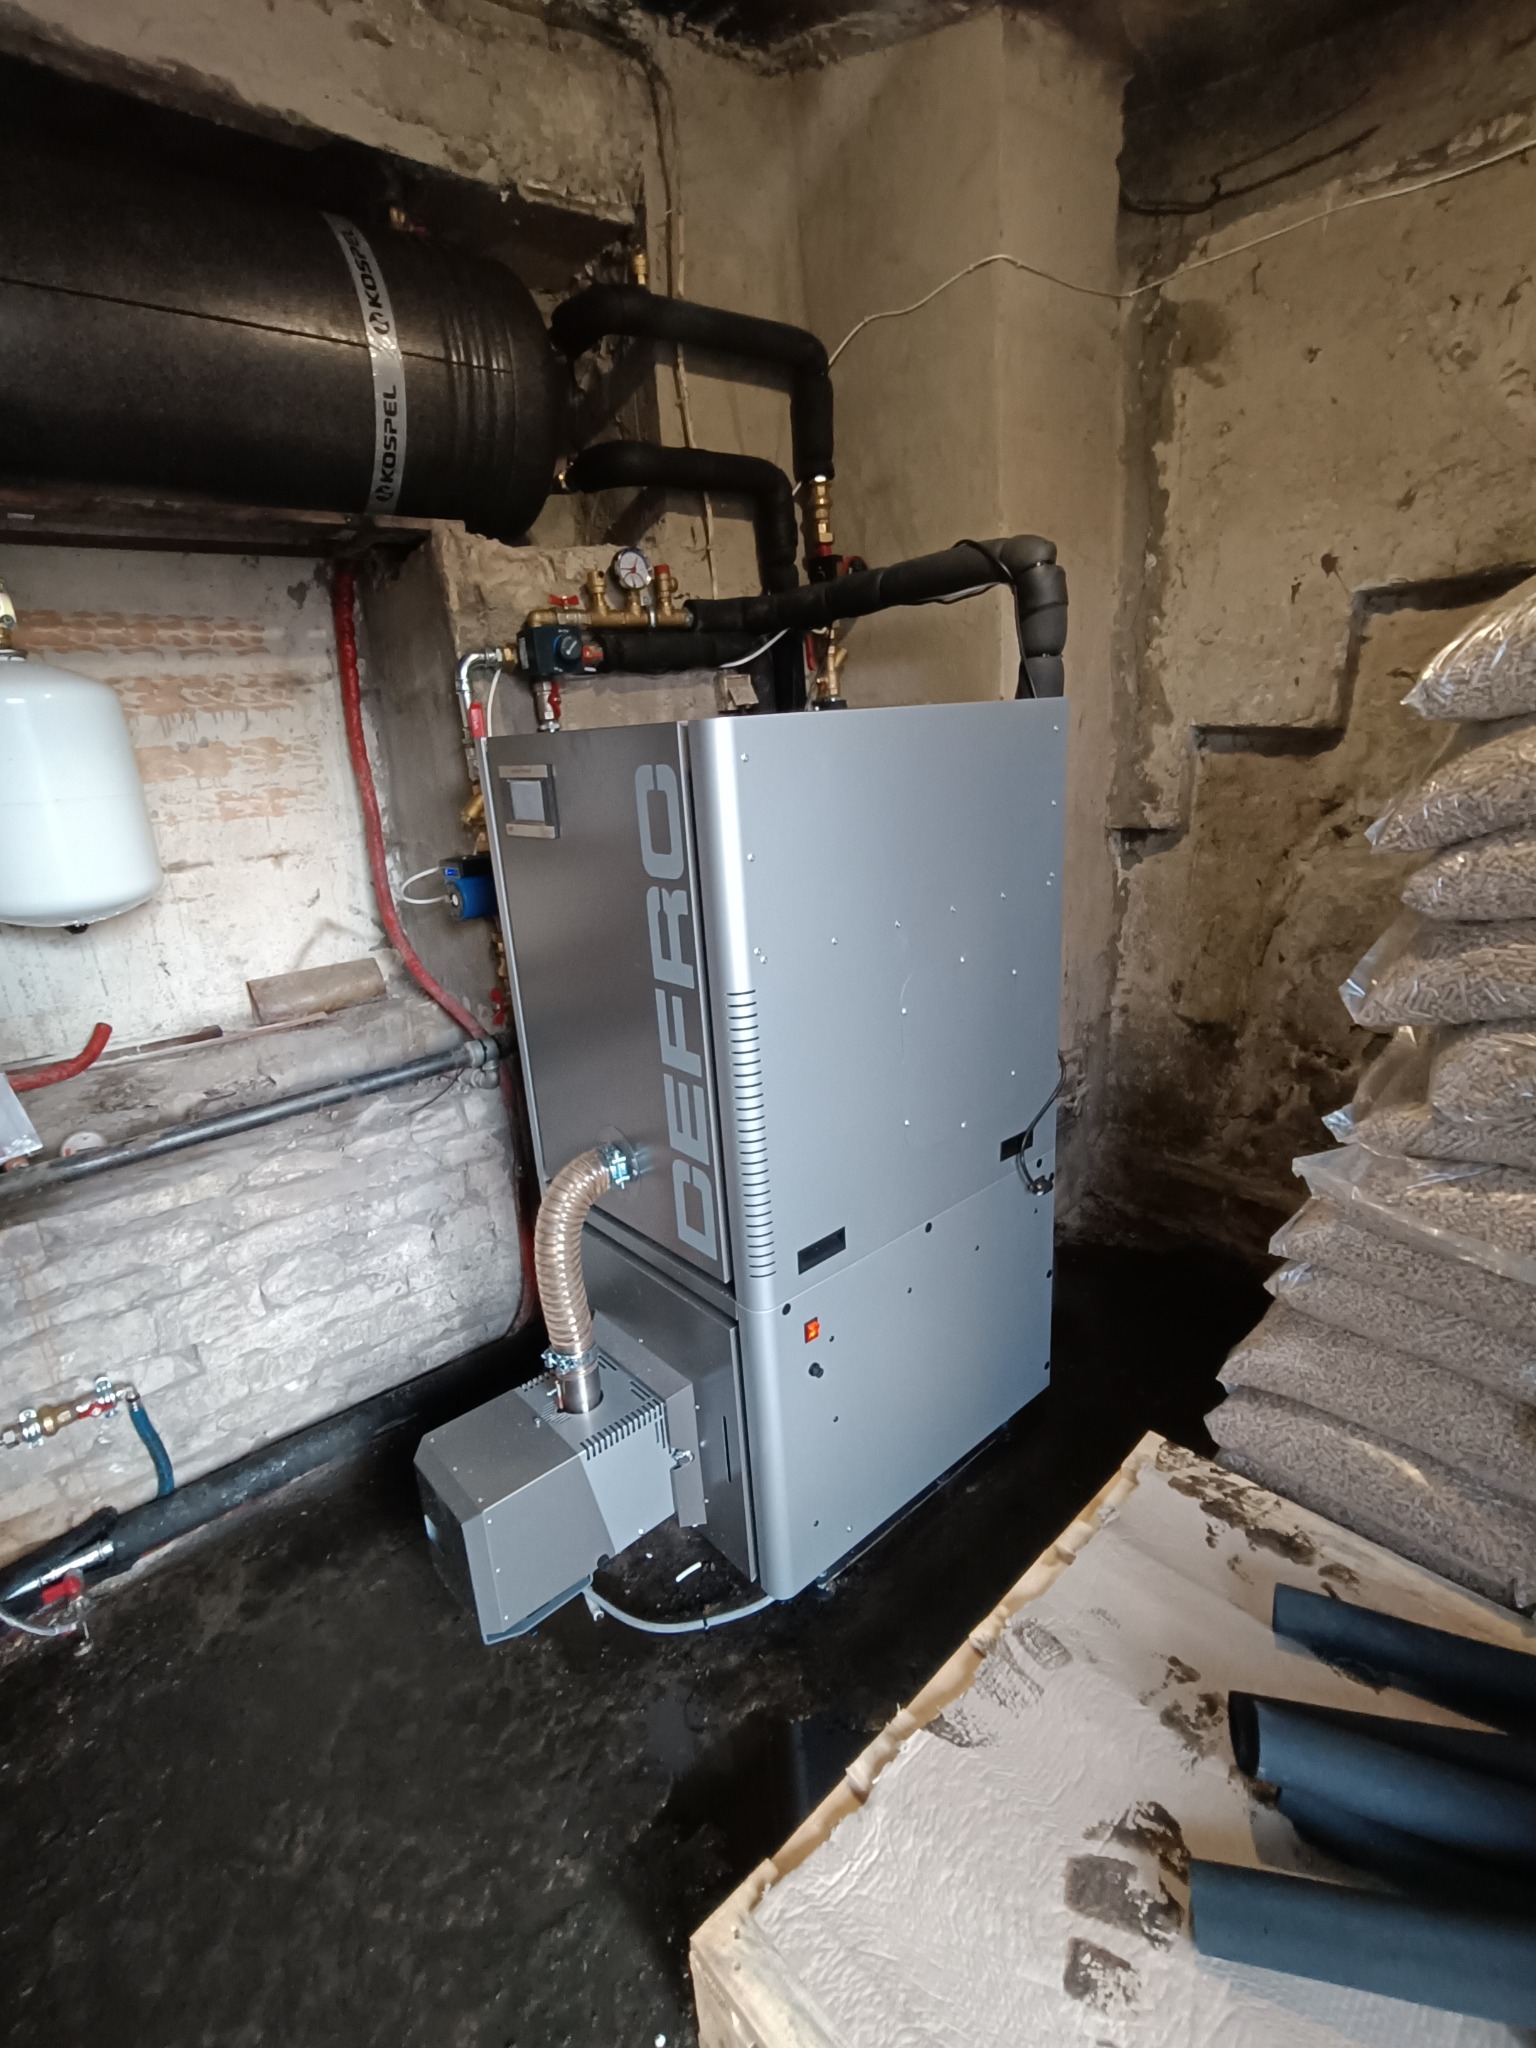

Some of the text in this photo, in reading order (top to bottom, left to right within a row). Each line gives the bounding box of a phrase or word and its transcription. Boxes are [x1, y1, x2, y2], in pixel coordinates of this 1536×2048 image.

[341, 230, 383, 309] KOSPEL
[380, 384, 398, 484] KOSPEL
[635, 763, 718, 1261] DEFRO
